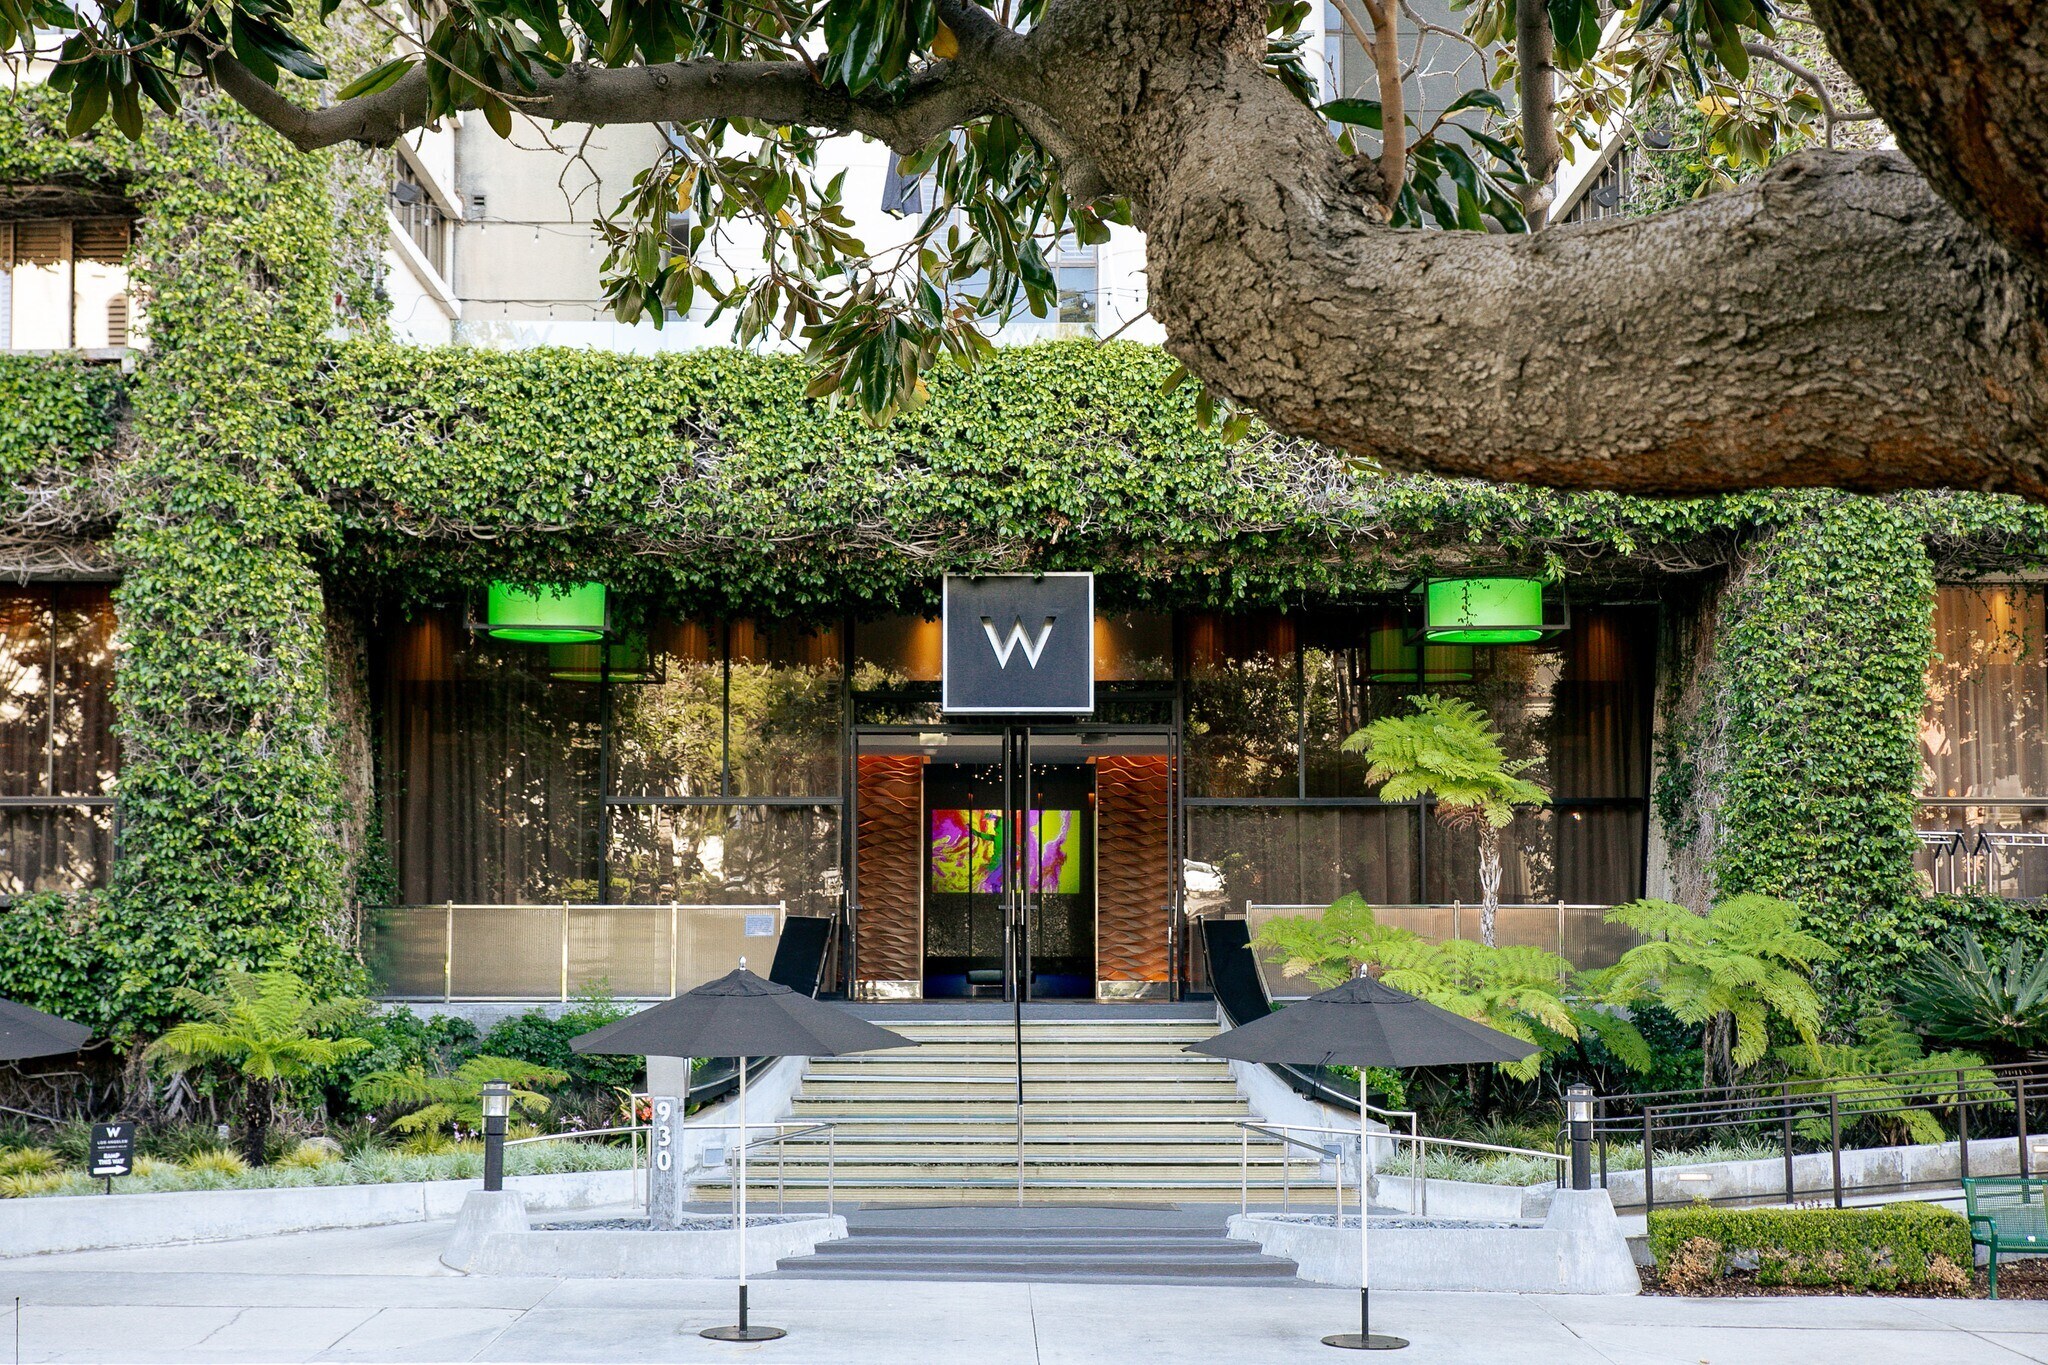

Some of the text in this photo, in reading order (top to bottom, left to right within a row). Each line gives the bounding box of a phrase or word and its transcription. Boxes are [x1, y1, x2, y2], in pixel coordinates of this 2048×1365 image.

[979, 615, 1057, 670] W
[1525, 845, 1536, 853] W
[106, 1127, 121, 1138] W
[656, 1101, 672, 1171] 930
